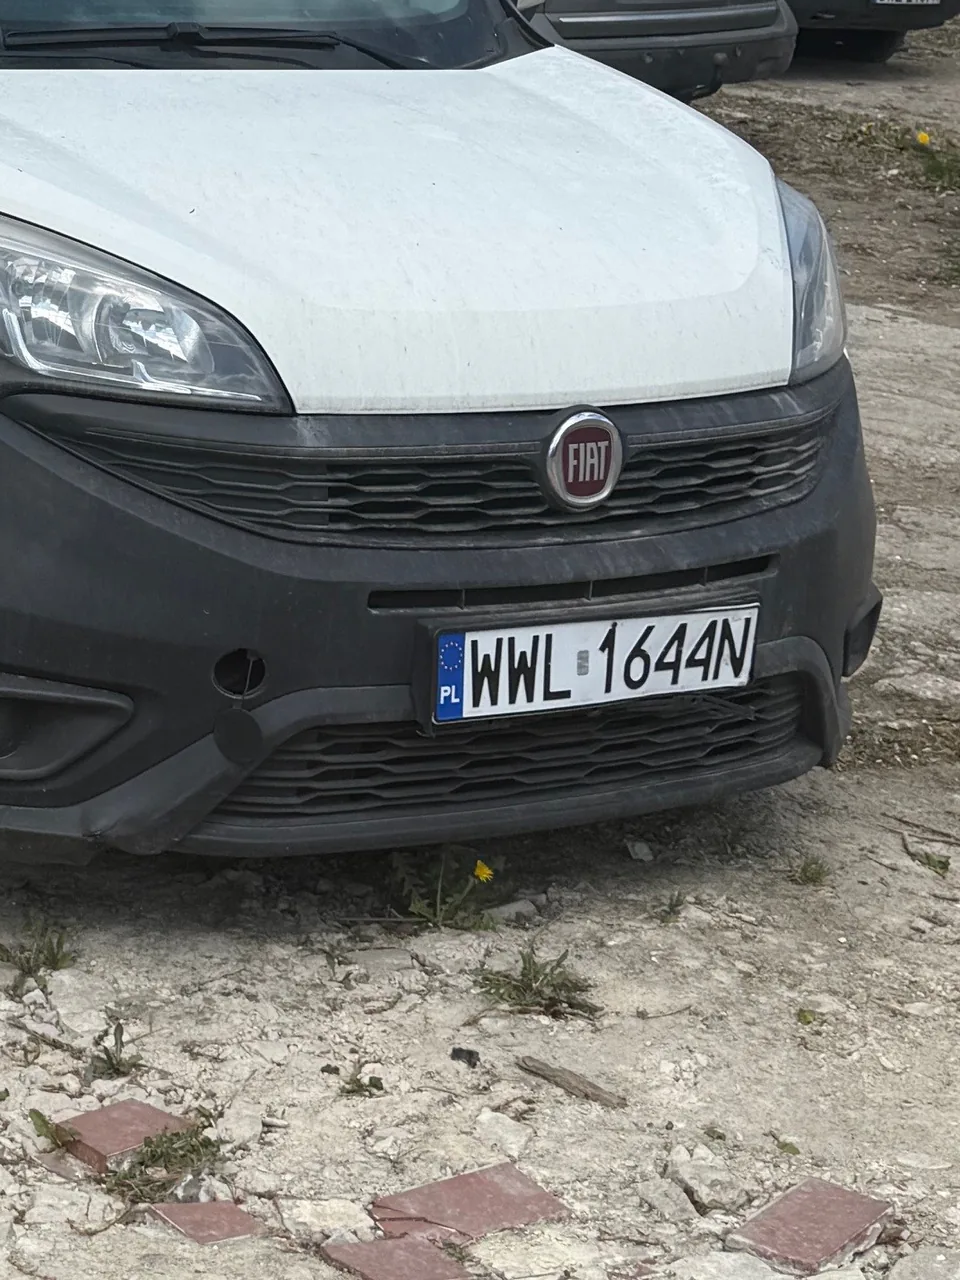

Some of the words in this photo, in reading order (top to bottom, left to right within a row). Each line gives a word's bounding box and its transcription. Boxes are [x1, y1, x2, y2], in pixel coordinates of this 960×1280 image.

[567, 440, 610, 483] FIAT
[440, 685, 460, 704] PL
[471, 633, 571, 708] WWL
[598, 616, 752, 694] 1644N
